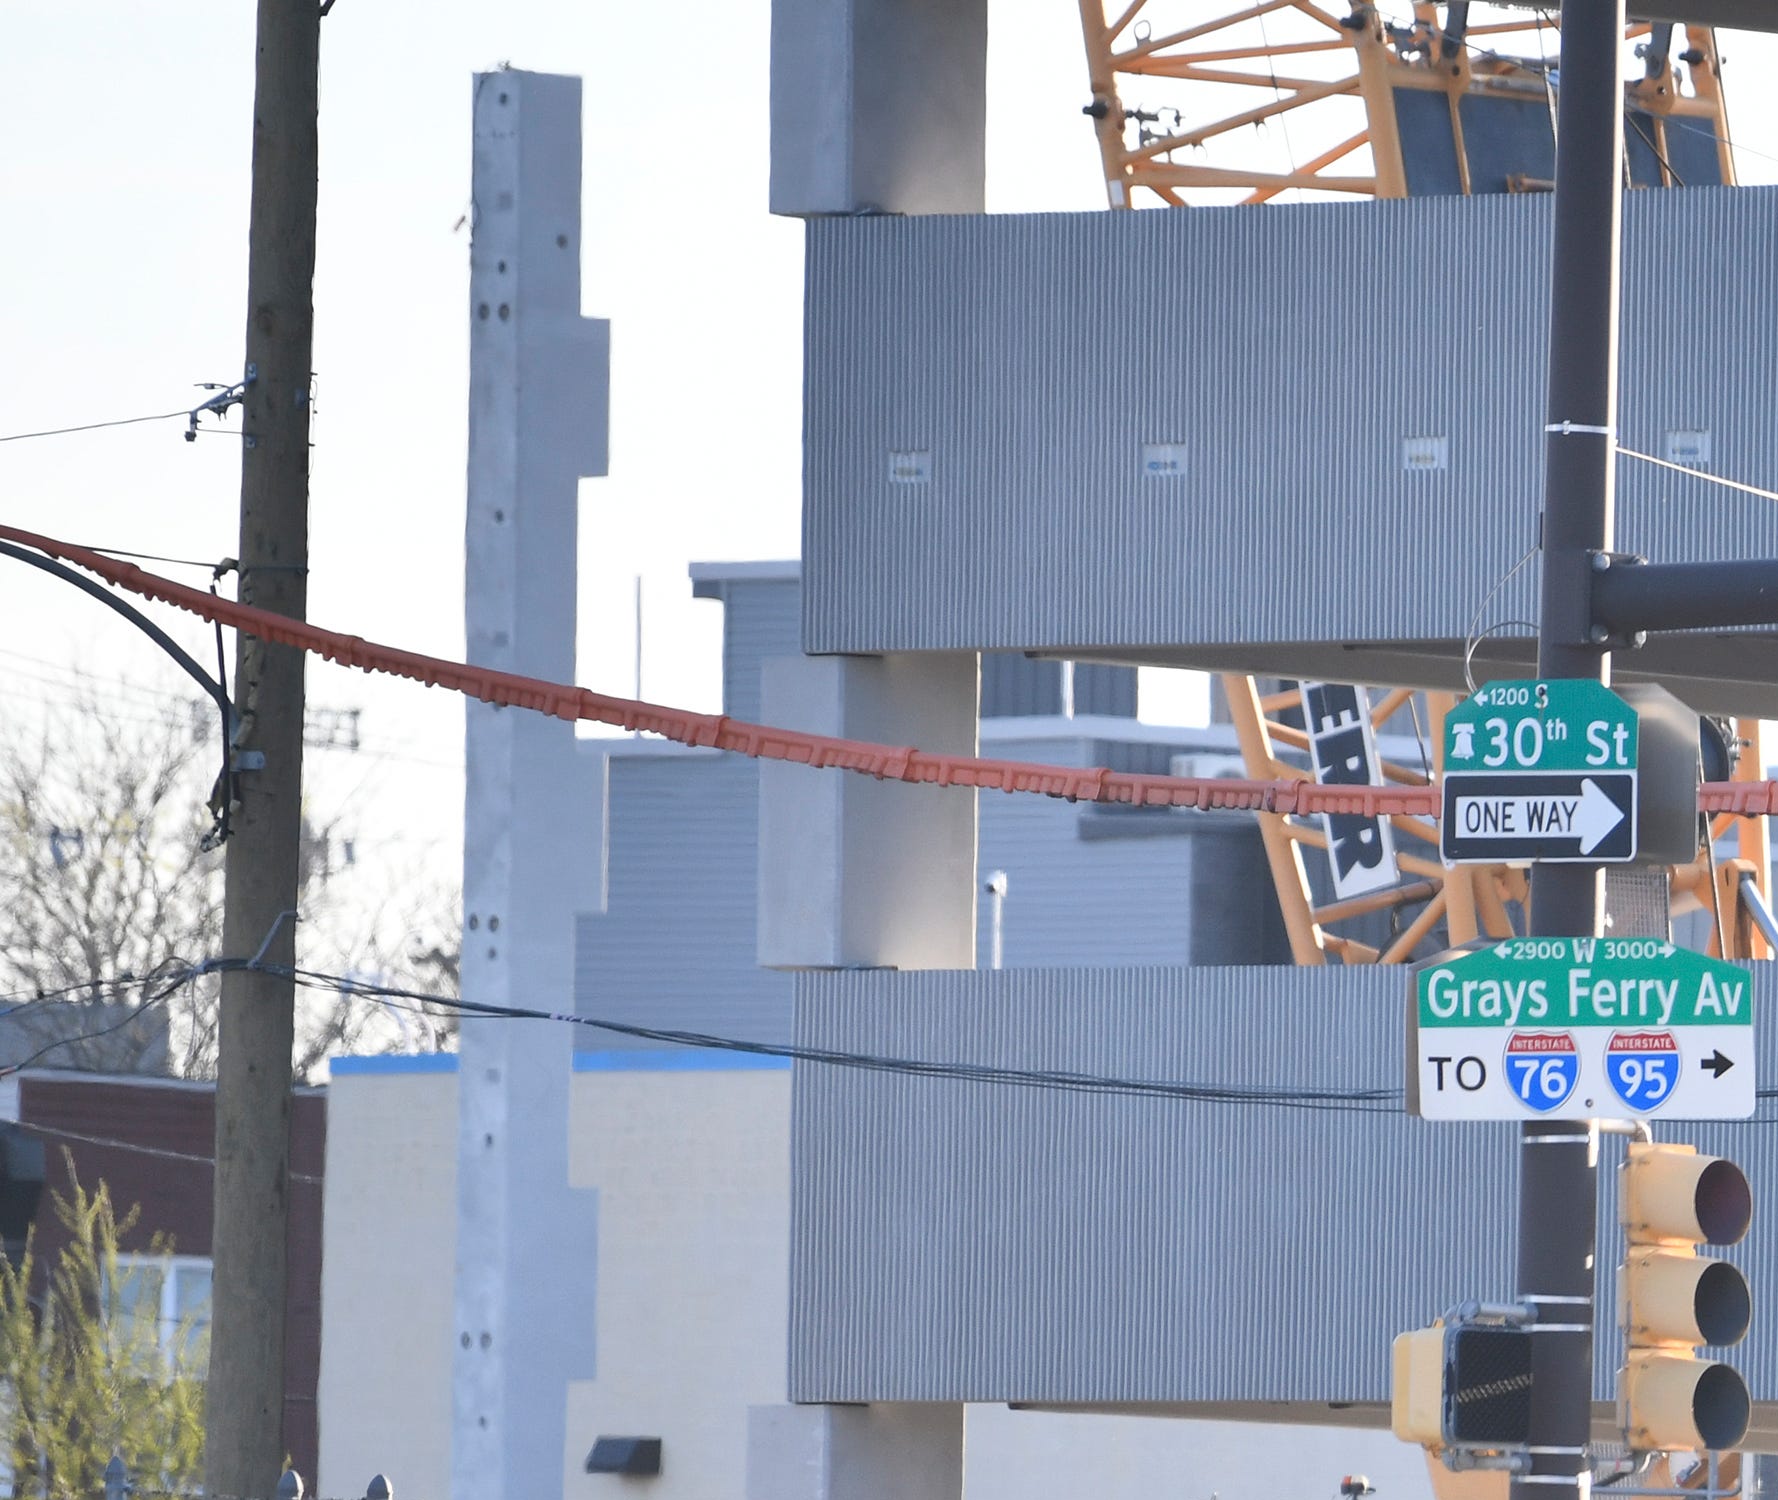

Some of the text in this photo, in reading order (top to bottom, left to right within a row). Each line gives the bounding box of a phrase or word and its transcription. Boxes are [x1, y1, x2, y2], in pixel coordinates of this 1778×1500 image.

[1491, 684, 1549, 710] 1200 S
[1586, 720, 1629, 765] St
[1465, 801, 1578, 833] ONE WAY
[1513, 938, 1657, 963] 2900 W 3000
[1427, 969, 1743, 1027] Grays Ferry Av
[1512, 1037, 1571, 1051] INTERSTATE
[1612, 1036, 1673, 1050] INTERSTATE
[1428, 1056, 1668, 1099] TO 76 95
